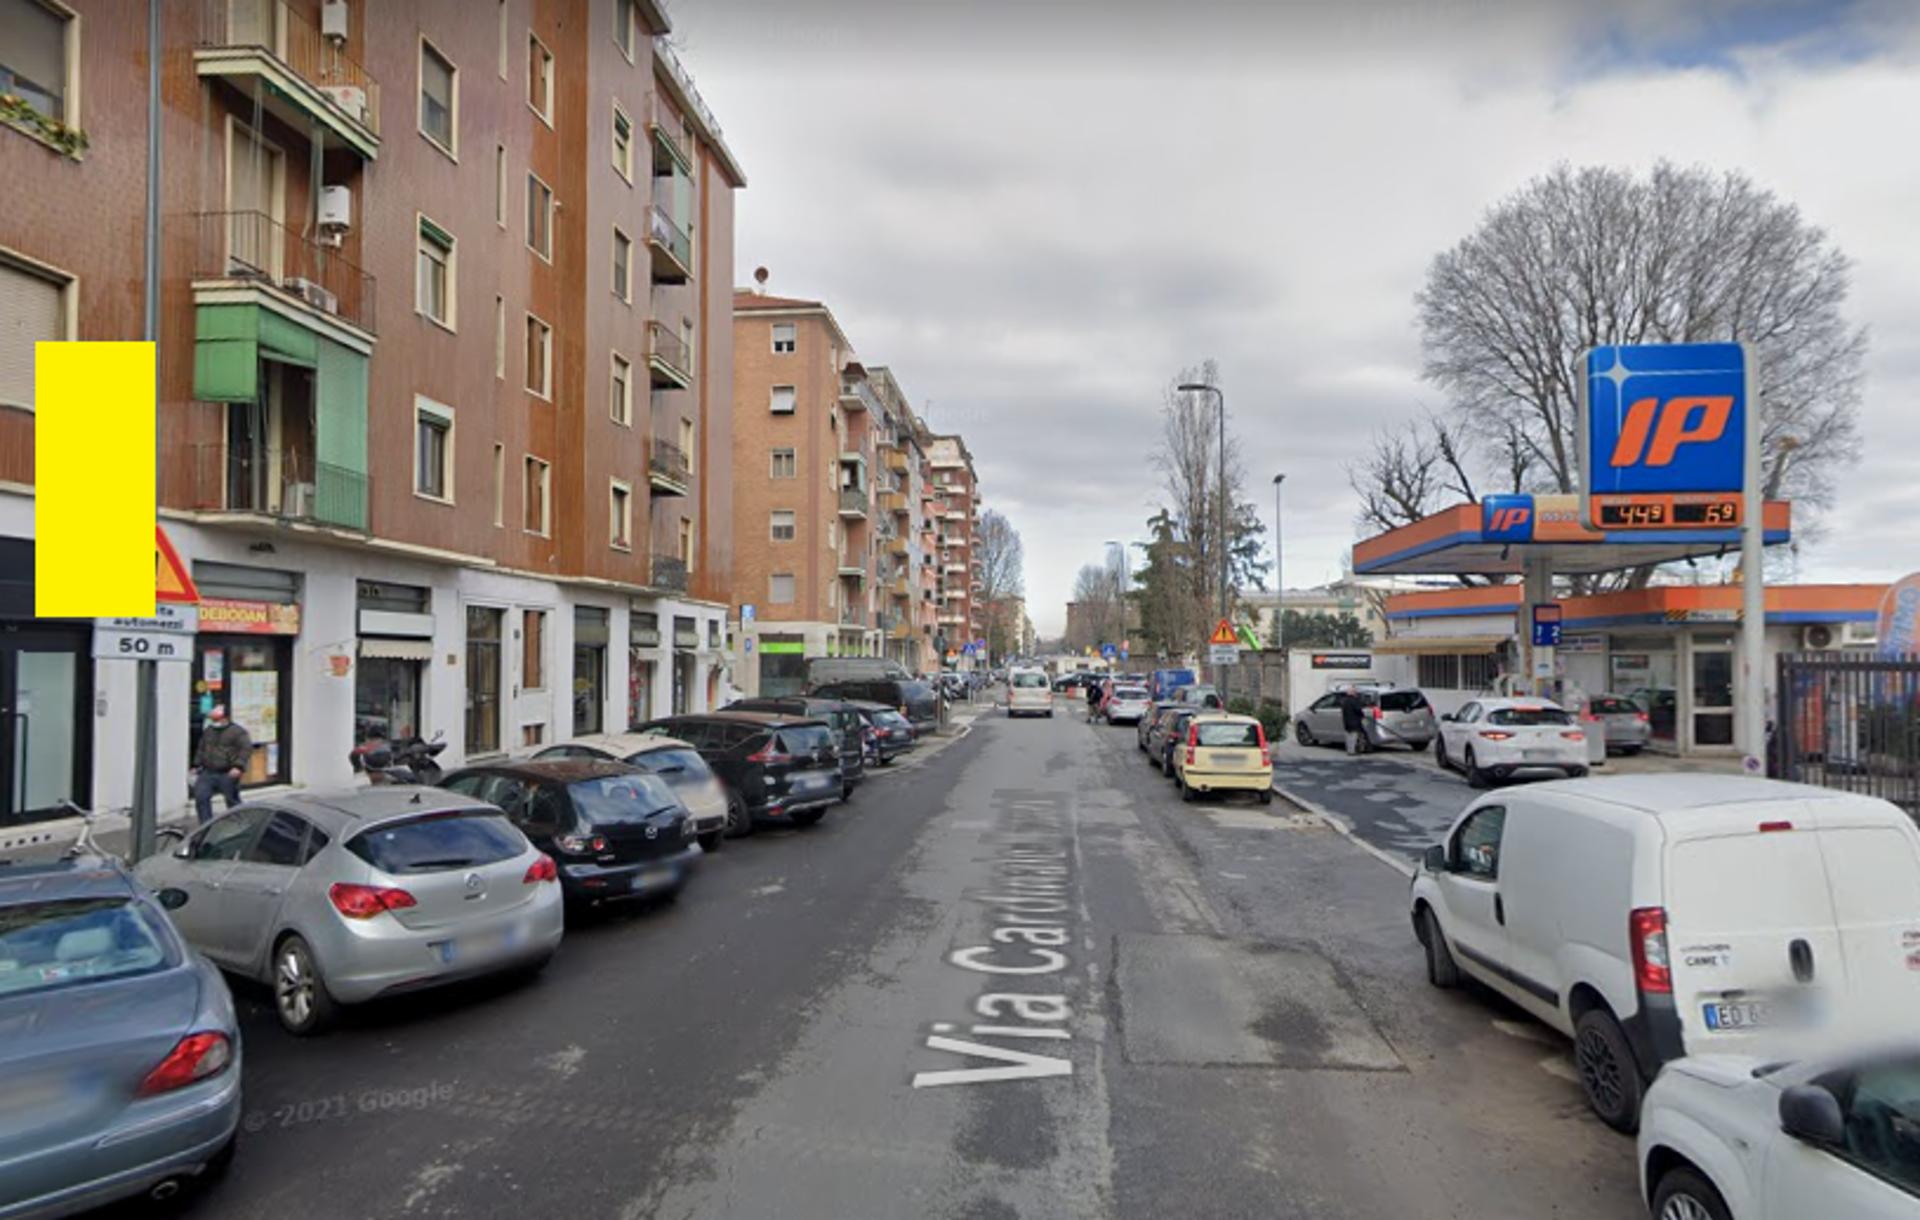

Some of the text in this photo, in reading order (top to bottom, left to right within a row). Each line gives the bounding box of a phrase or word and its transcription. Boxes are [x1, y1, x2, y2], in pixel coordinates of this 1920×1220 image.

[1610, 395, 1735, 467] IP
[1489, 508, 1531, 531] IP
[1551, 625, 1560, 636] 2
[119, 637, 175, 656] 50 m
